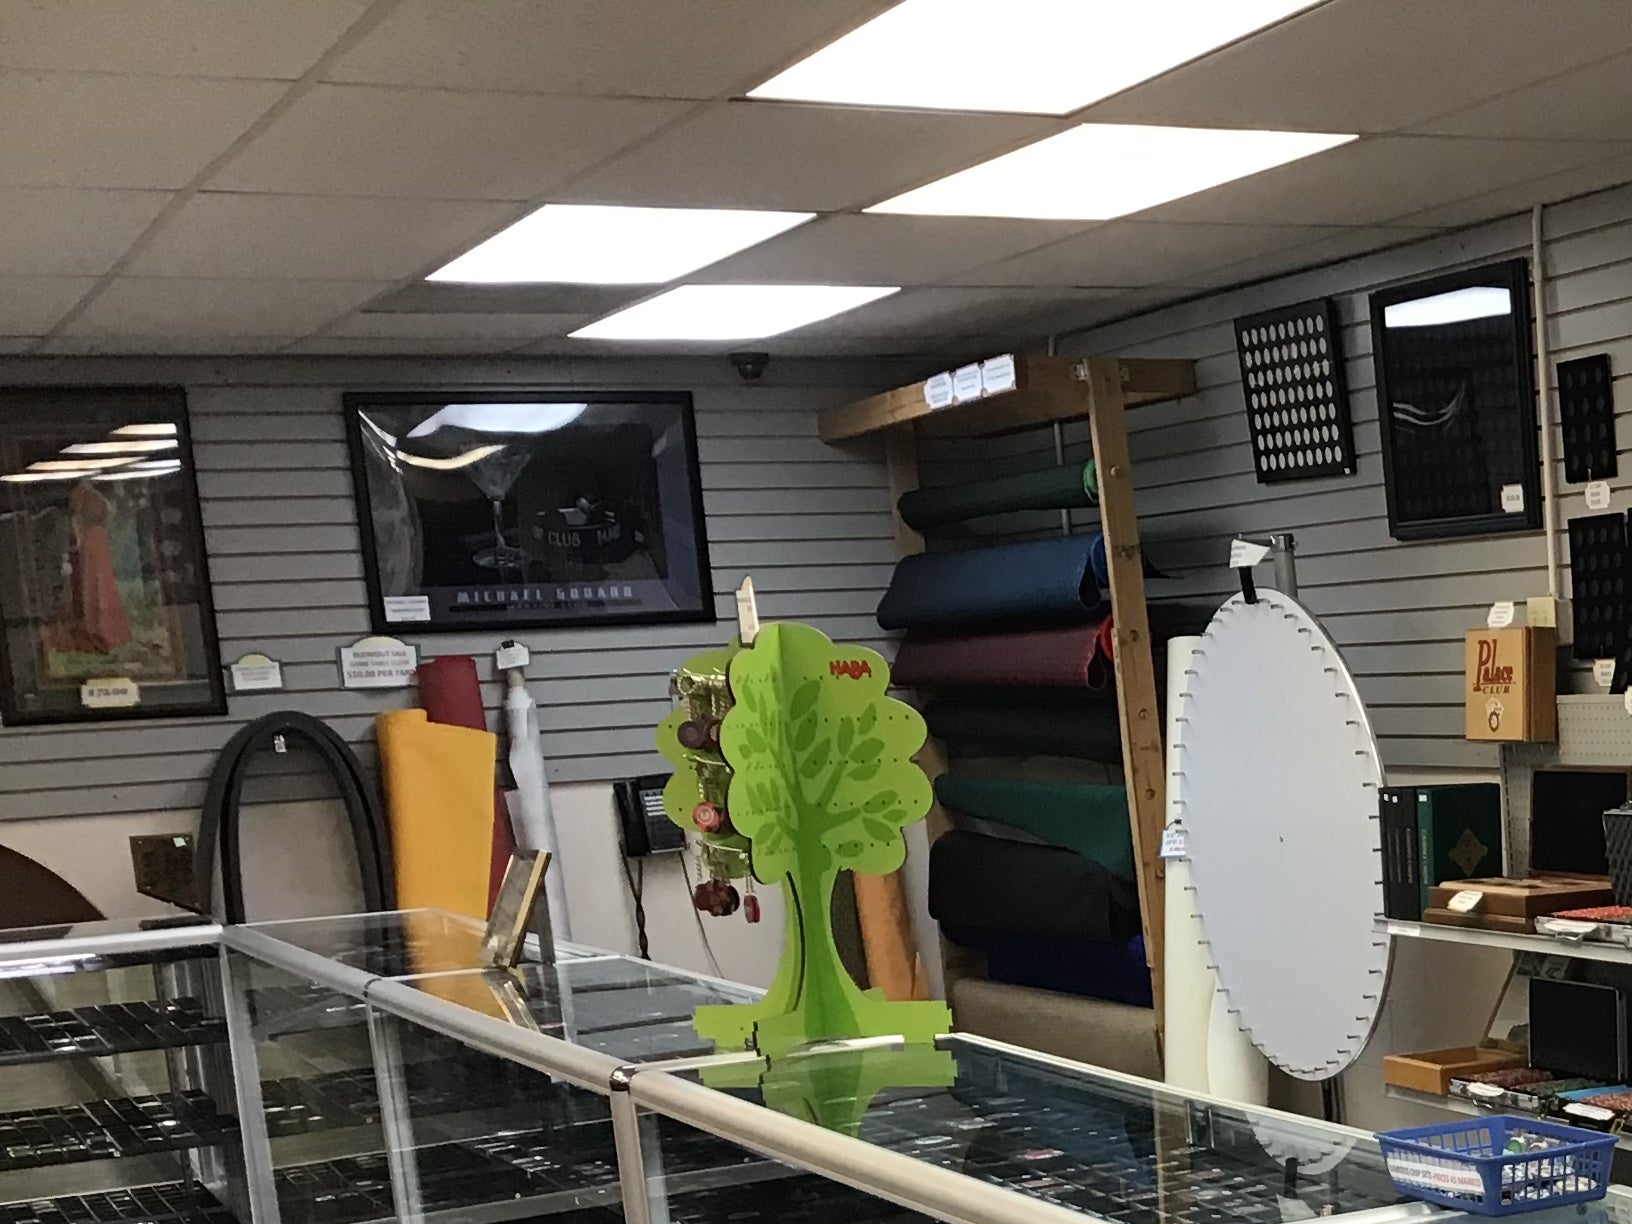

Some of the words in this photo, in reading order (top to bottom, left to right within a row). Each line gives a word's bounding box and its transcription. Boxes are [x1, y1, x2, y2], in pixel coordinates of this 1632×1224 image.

[457, 589, 542, 603] MICHAEL
[829, 659, 872, 680] HABA
[1473, 638, 1514, 692] Palace
[1482, 684, 1512, 695] CLUB
